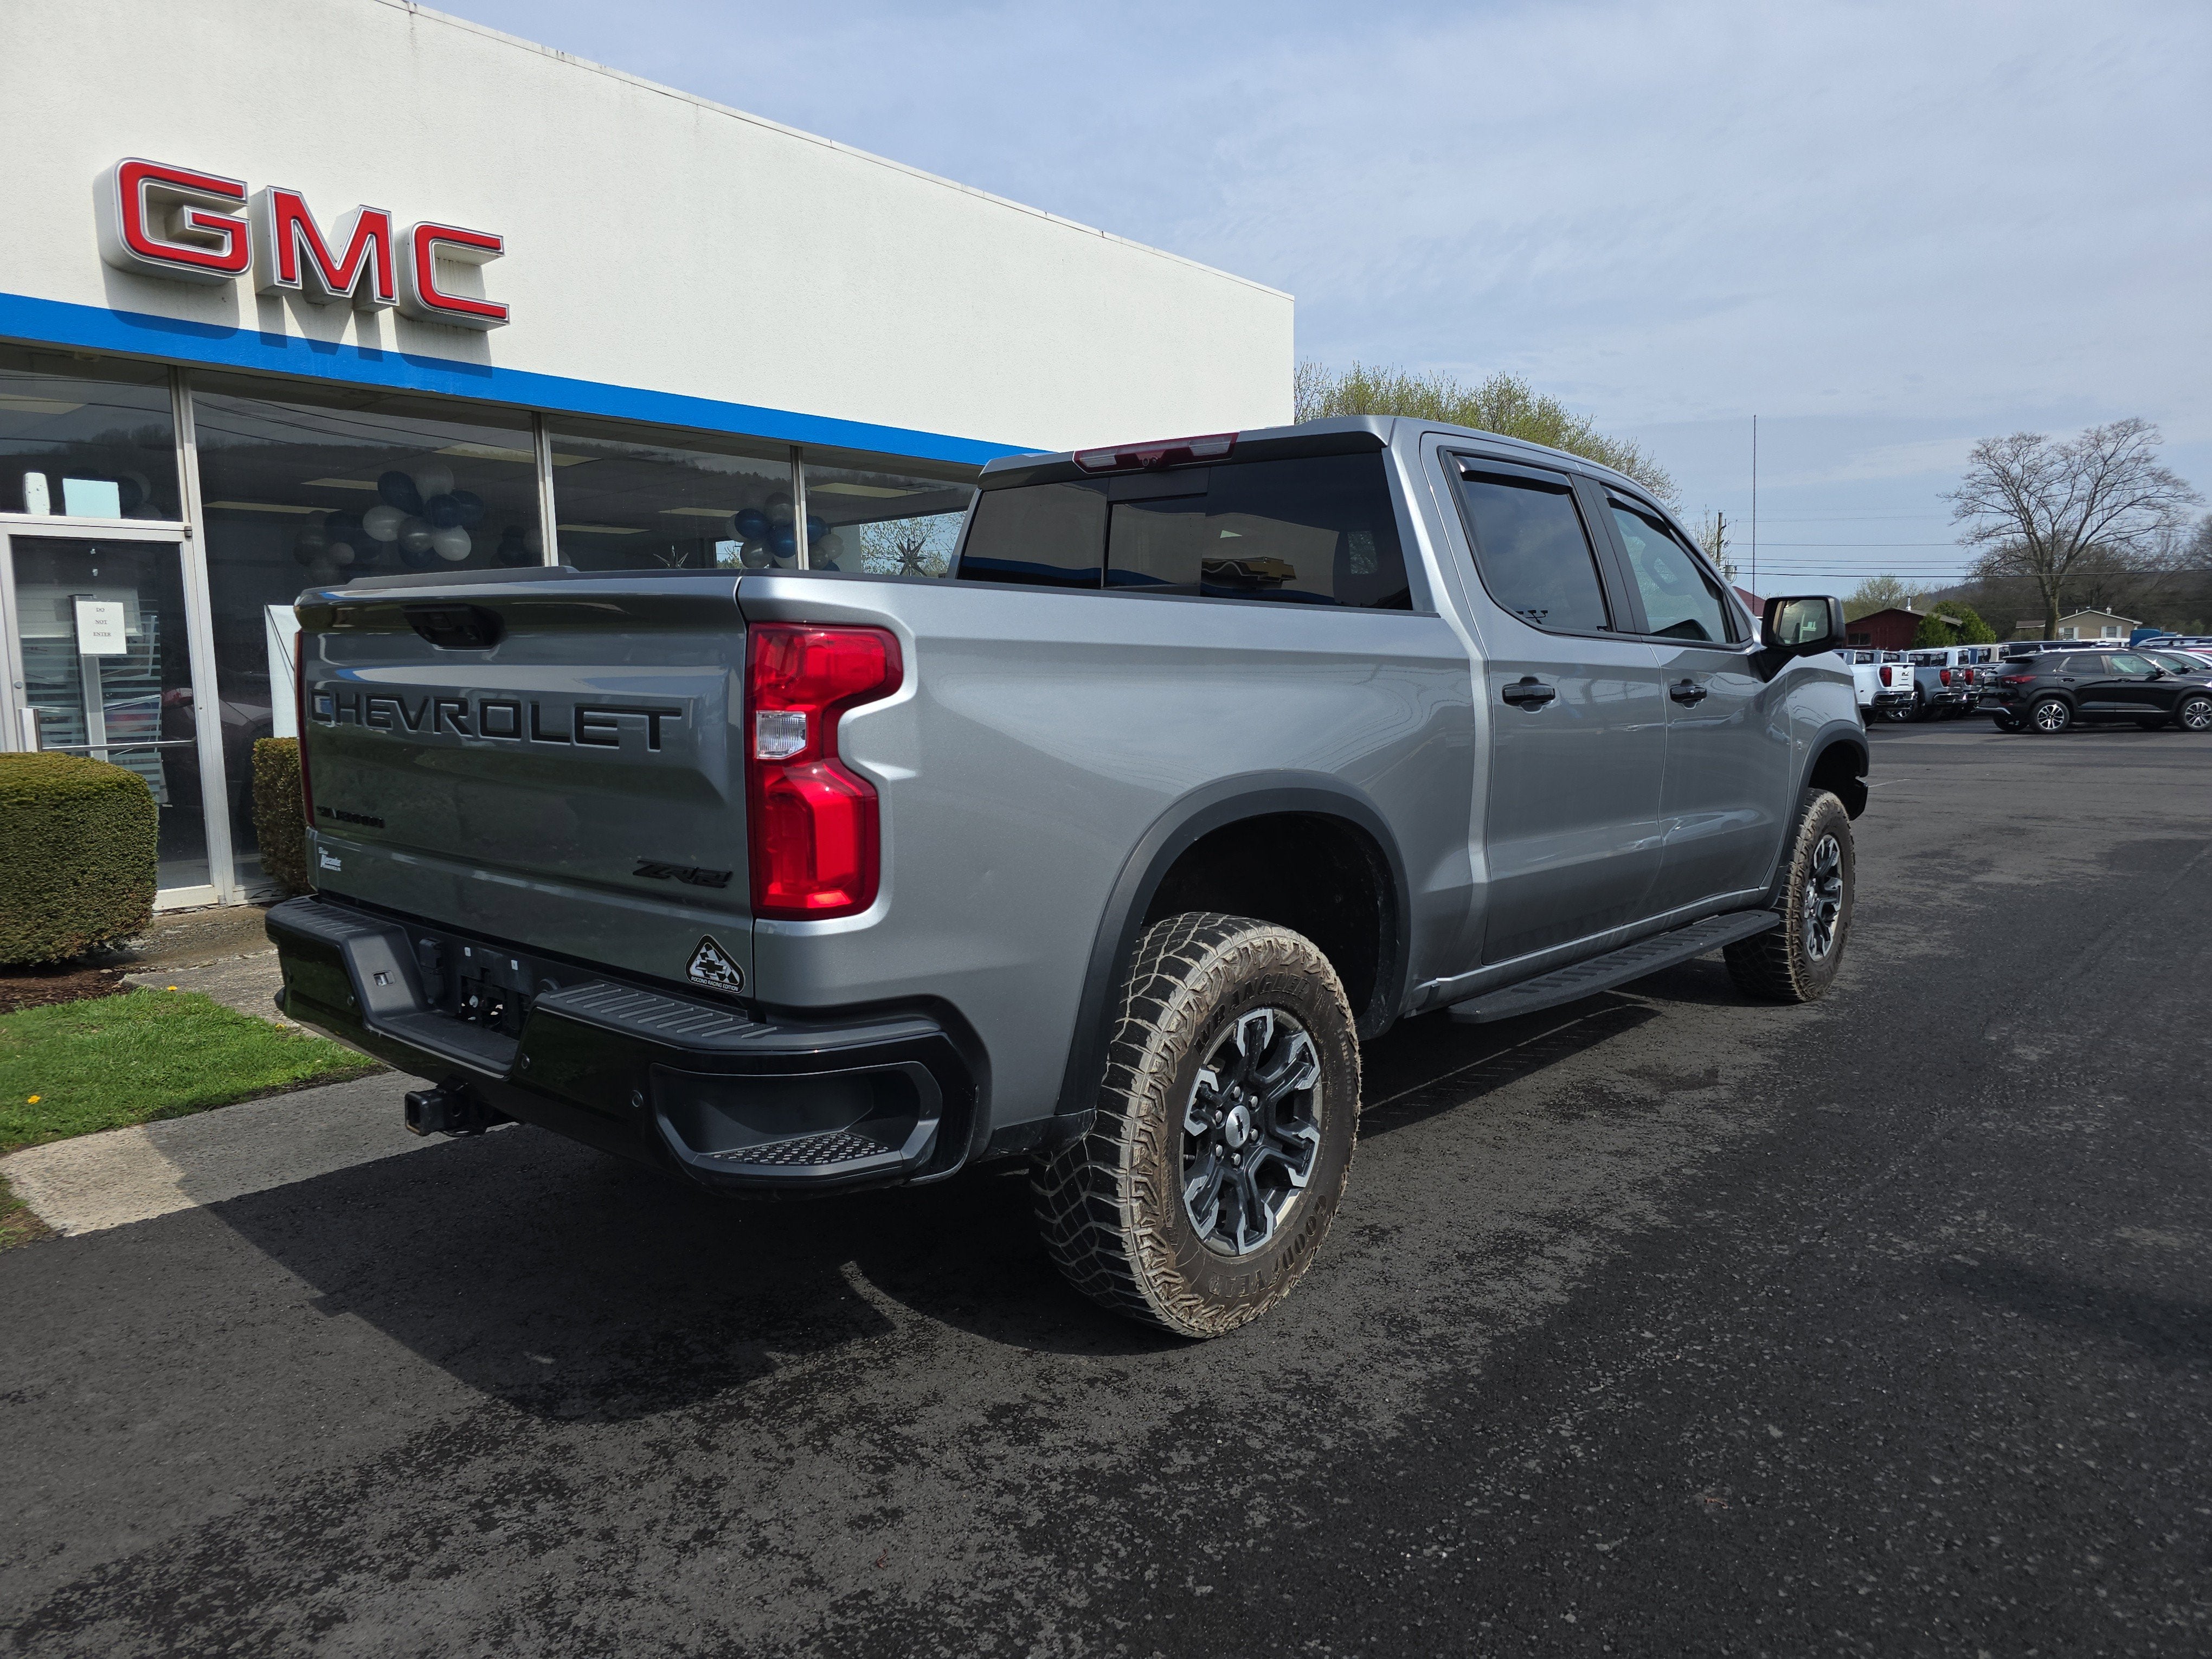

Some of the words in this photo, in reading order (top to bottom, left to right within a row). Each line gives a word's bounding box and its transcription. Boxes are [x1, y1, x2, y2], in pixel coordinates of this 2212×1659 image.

[111, 157, 511, 327] GMC
[311, 689, 682, 753] CHEVROLET
[632, 859, 734, 889] ZR2
[691, 976, 708, 985] POCONO
[708, 980, 722, 988] RACING
[1194, 972, 1311, 1056] WRANGLER
